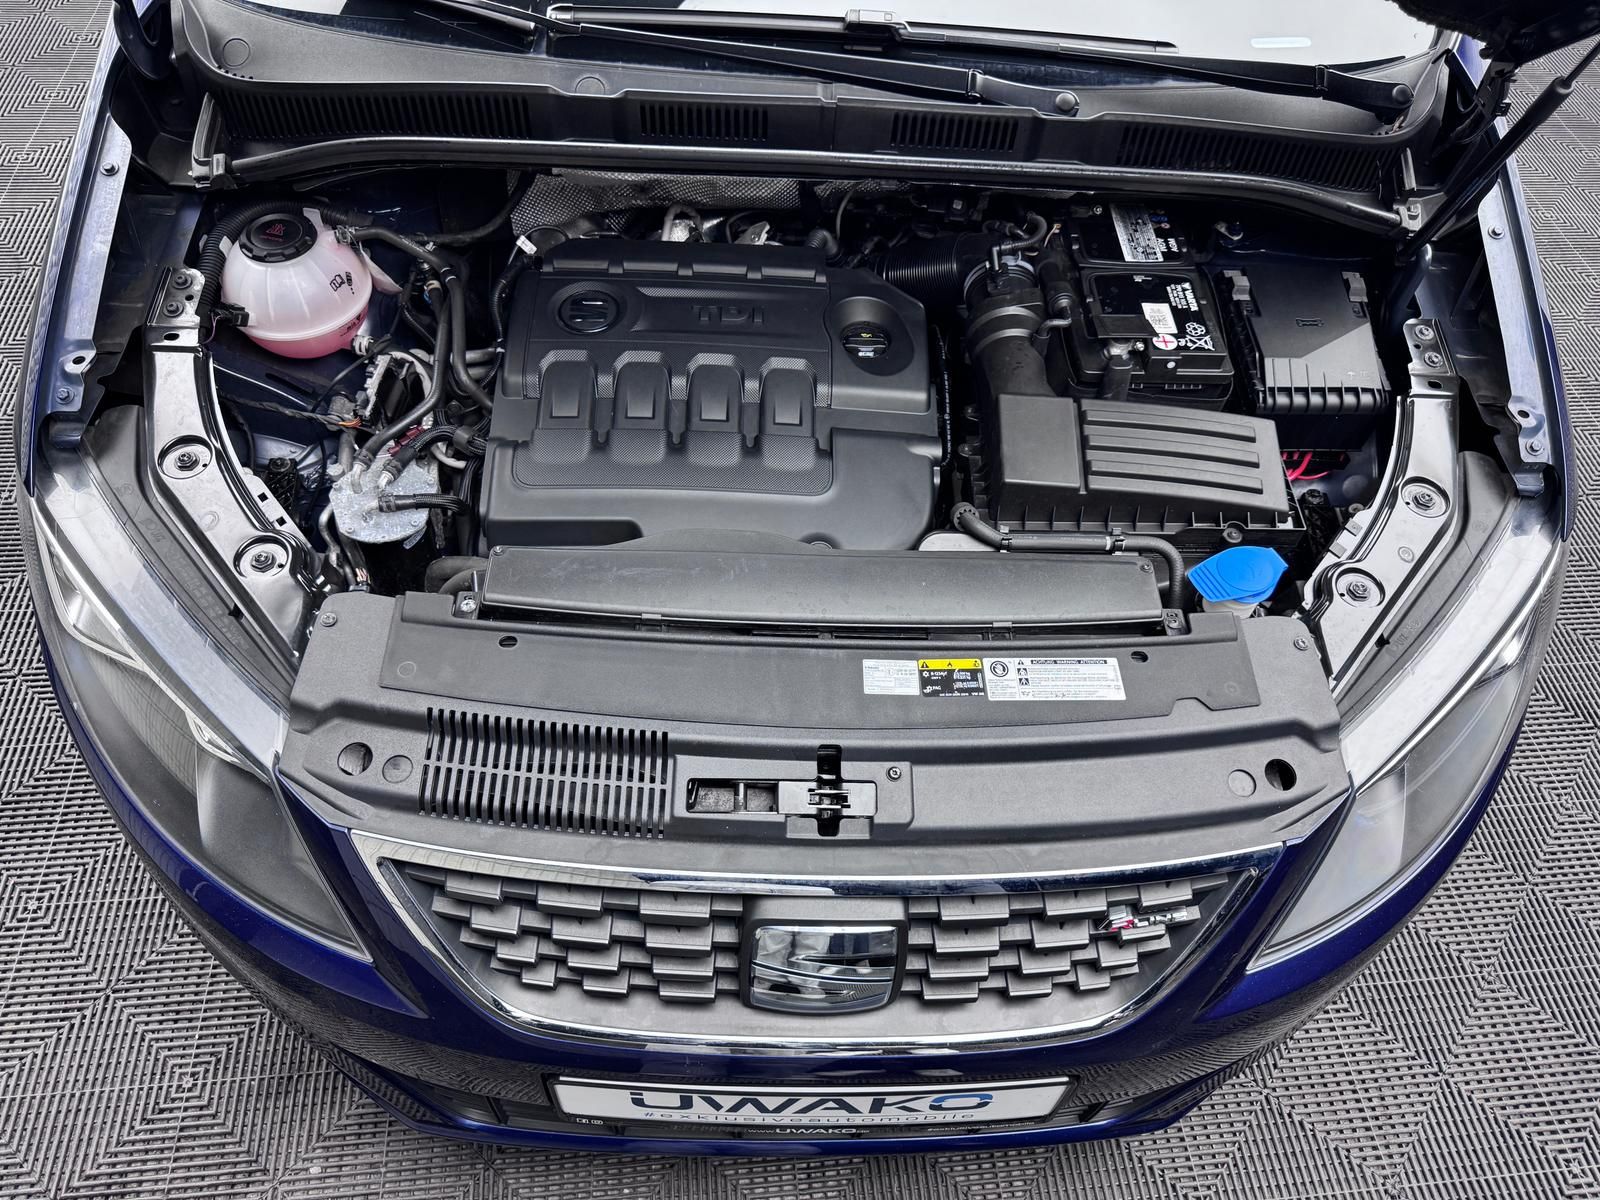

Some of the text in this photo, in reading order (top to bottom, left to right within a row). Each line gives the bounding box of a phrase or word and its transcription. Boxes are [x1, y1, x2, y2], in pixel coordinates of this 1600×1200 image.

[1184, 290, 1199, 311] VARTA
[690, 305, 766, 323] TDI
[629, 1091, 994, 1114] UWAKO
[643, 1112, 975, 1123] #exklusiveautomobile
